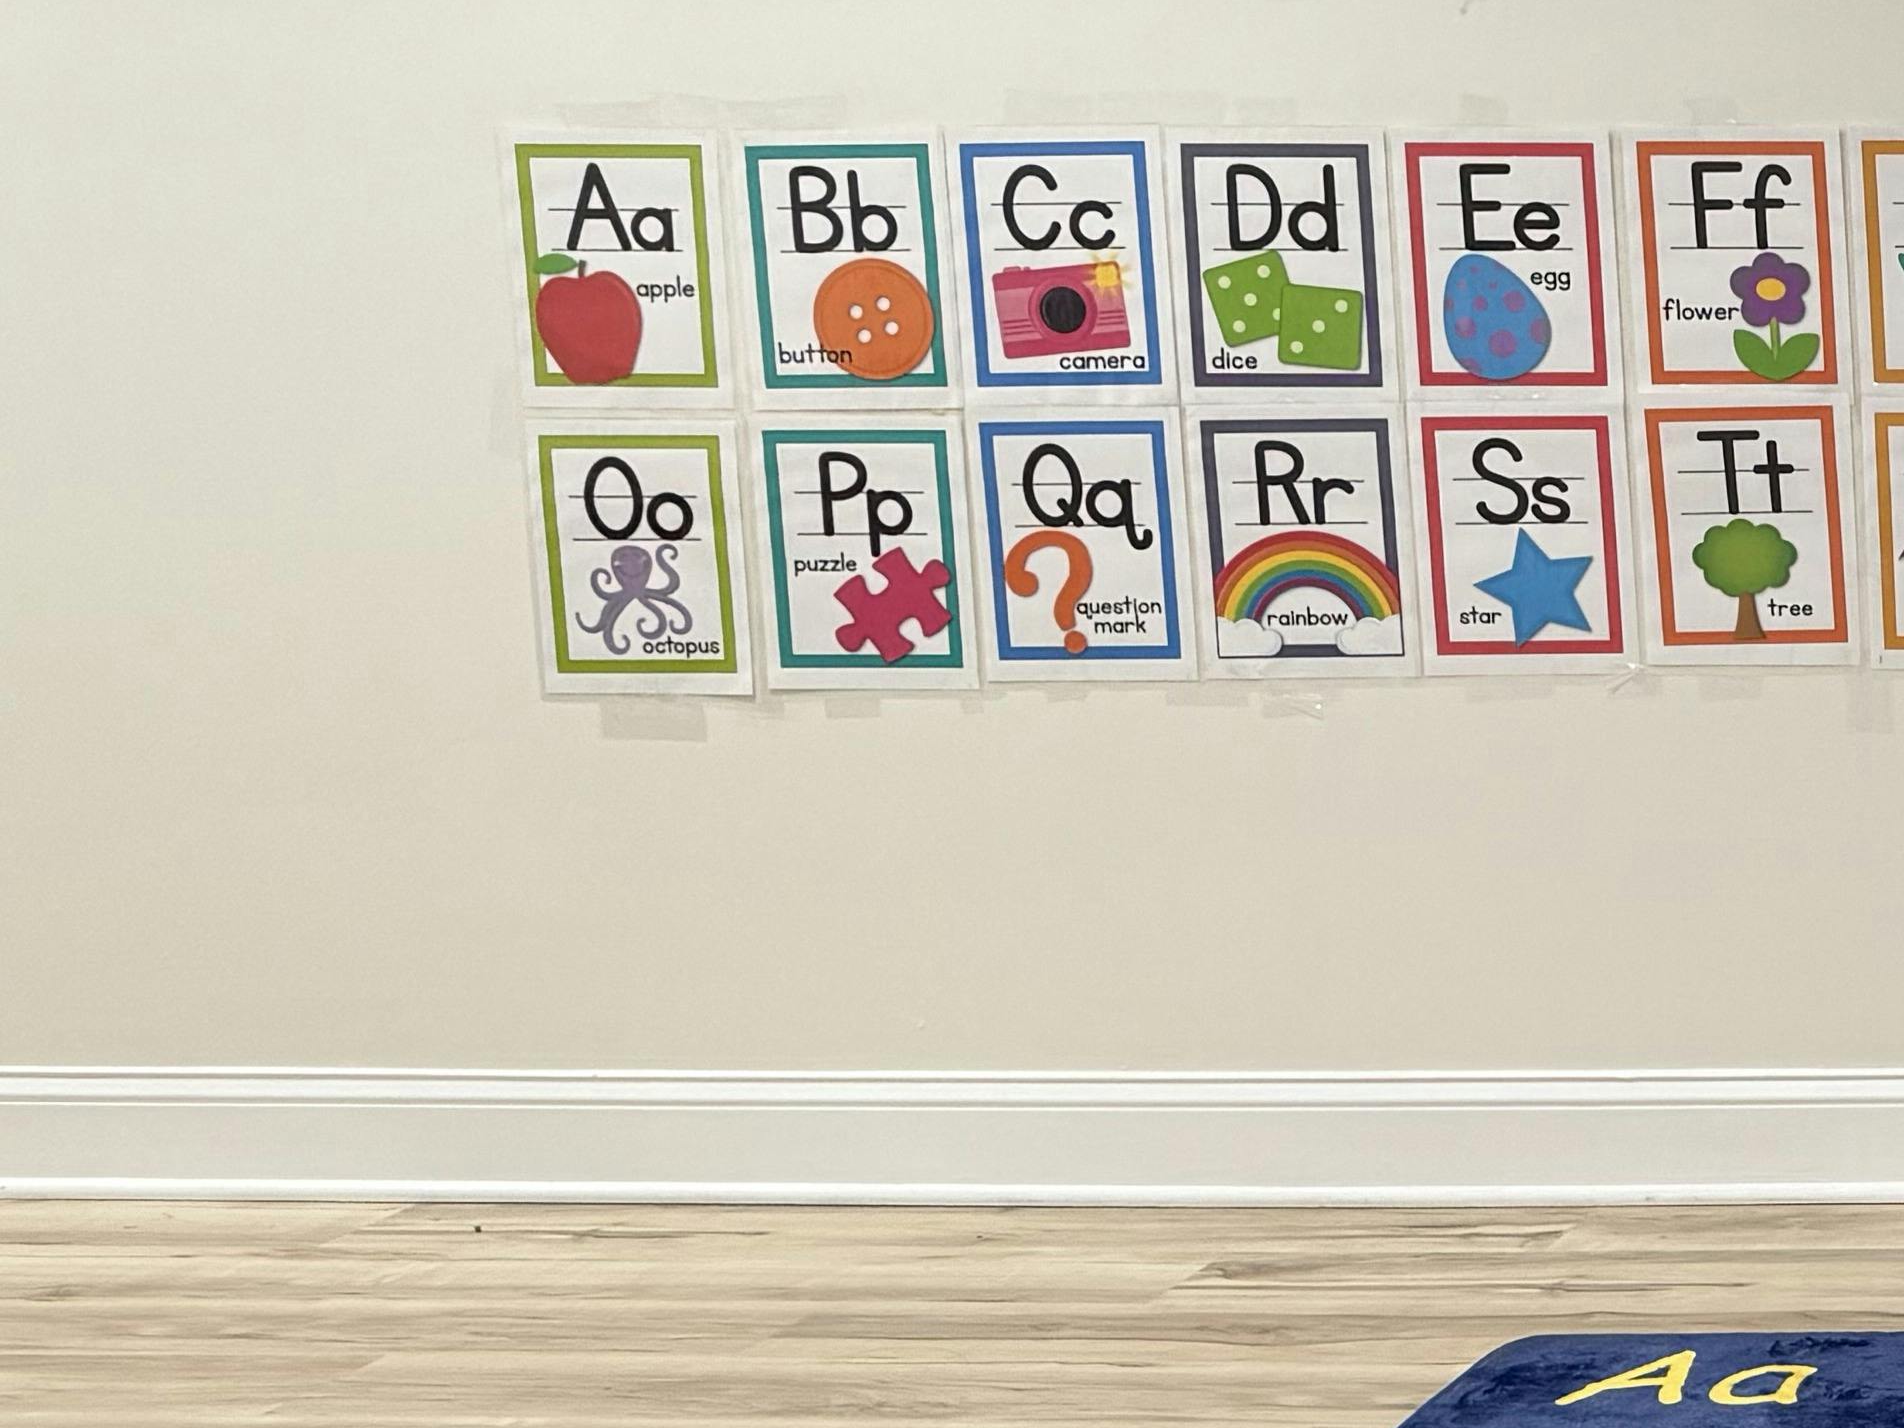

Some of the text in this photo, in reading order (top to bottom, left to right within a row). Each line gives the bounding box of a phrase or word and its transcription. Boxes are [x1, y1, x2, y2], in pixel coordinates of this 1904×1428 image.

[566, 162, 675, 253] Aa
[789, 165, 898, 254] Bb
[1002, 164, 1116, 252] Cc
[1226, 163, 1340, 253] Dd
[1459, 163, 1561, 252] Ee
[1690, 161, 1792, 251] Ff
[636, 275, 695, 303] apple
[1530, 271, 1571, 291] egg
[1662, 298, 1740, 321] flower
[778, 344, 853, 365] button
[1059, 355, 1146, 370] camera
[1211, 347, 1258, 370] dice
[794, 552, 857, 577] puzzle
[1076, 595, 1162, 620] question
[1267, 606, 1349, 627] rainbow
[1459, 605, 1502, 625] star
[1767, 598, 1813, 617] tree
[1093, 616, 1148, 634] mark
[642, 635, 720, 658] octopus
[1554, 1350, 1817, 1405] Aa
